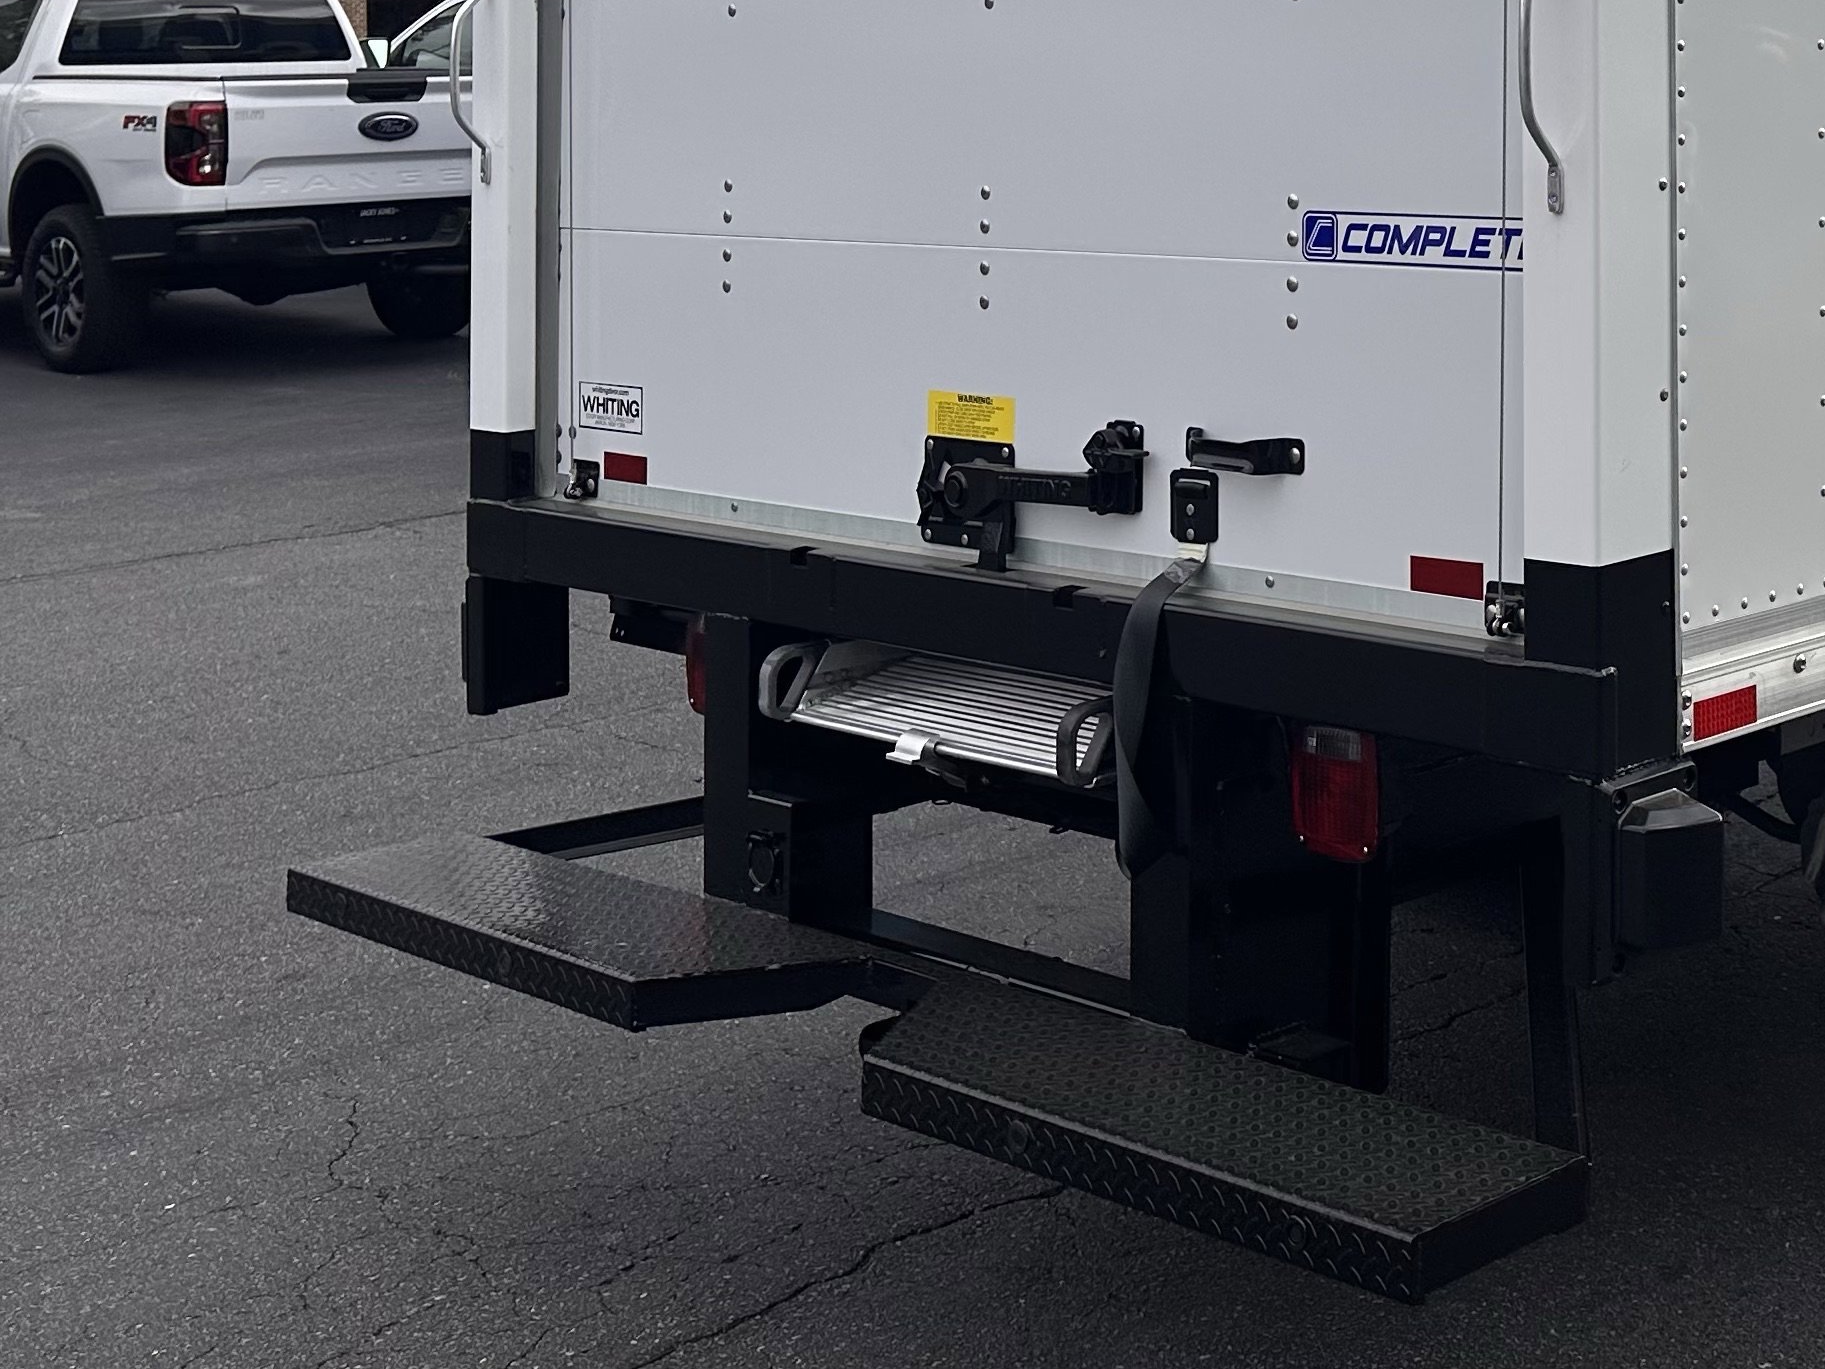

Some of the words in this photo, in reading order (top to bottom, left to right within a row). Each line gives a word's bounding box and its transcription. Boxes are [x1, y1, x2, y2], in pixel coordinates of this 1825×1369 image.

[122, 115, 157, 130] FX4
[377, 119, 406, 133] Ford
[581, 395, 640, 418] WHITING
